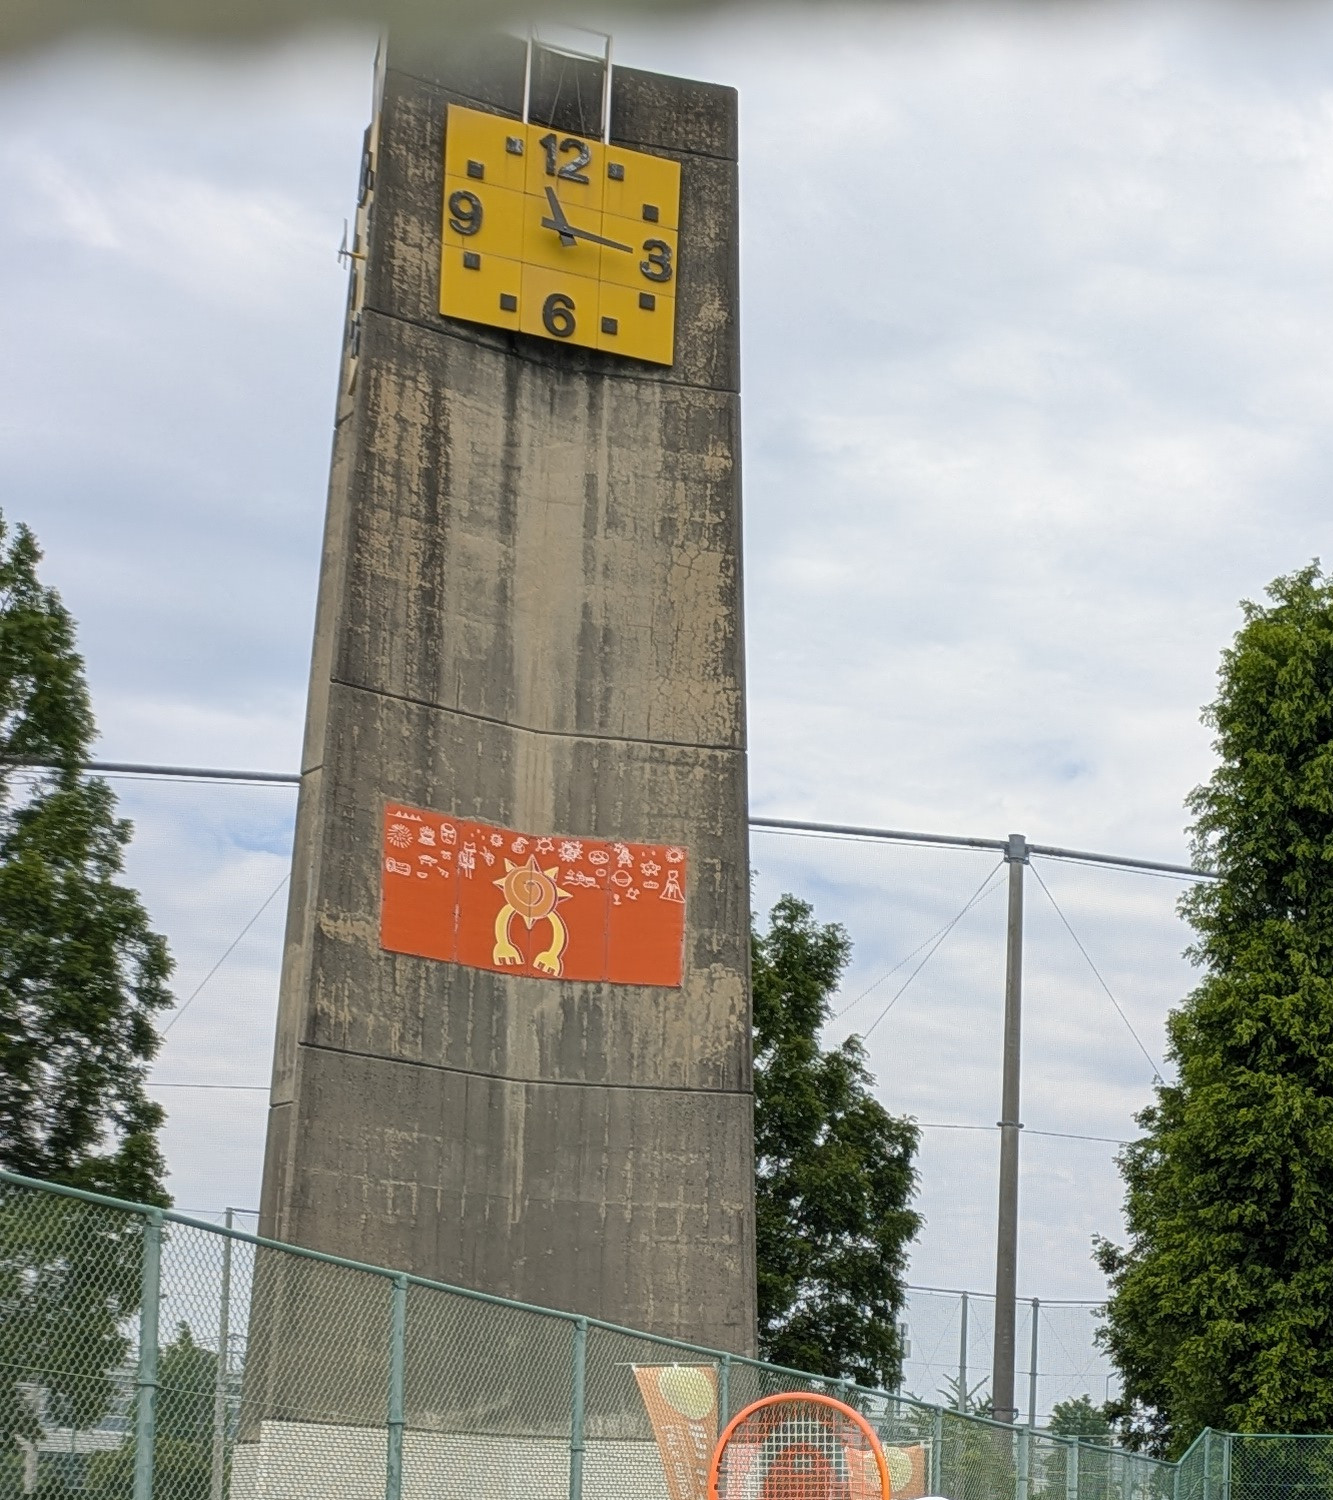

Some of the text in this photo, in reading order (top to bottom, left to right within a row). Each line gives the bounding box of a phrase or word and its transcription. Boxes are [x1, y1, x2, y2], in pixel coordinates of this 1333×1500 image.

[539, 133, 590, 184] 12
[448, 190, 483, 236] 9
[640, 239, 673, 283] 3
[542, 293, 576, 338] 6
